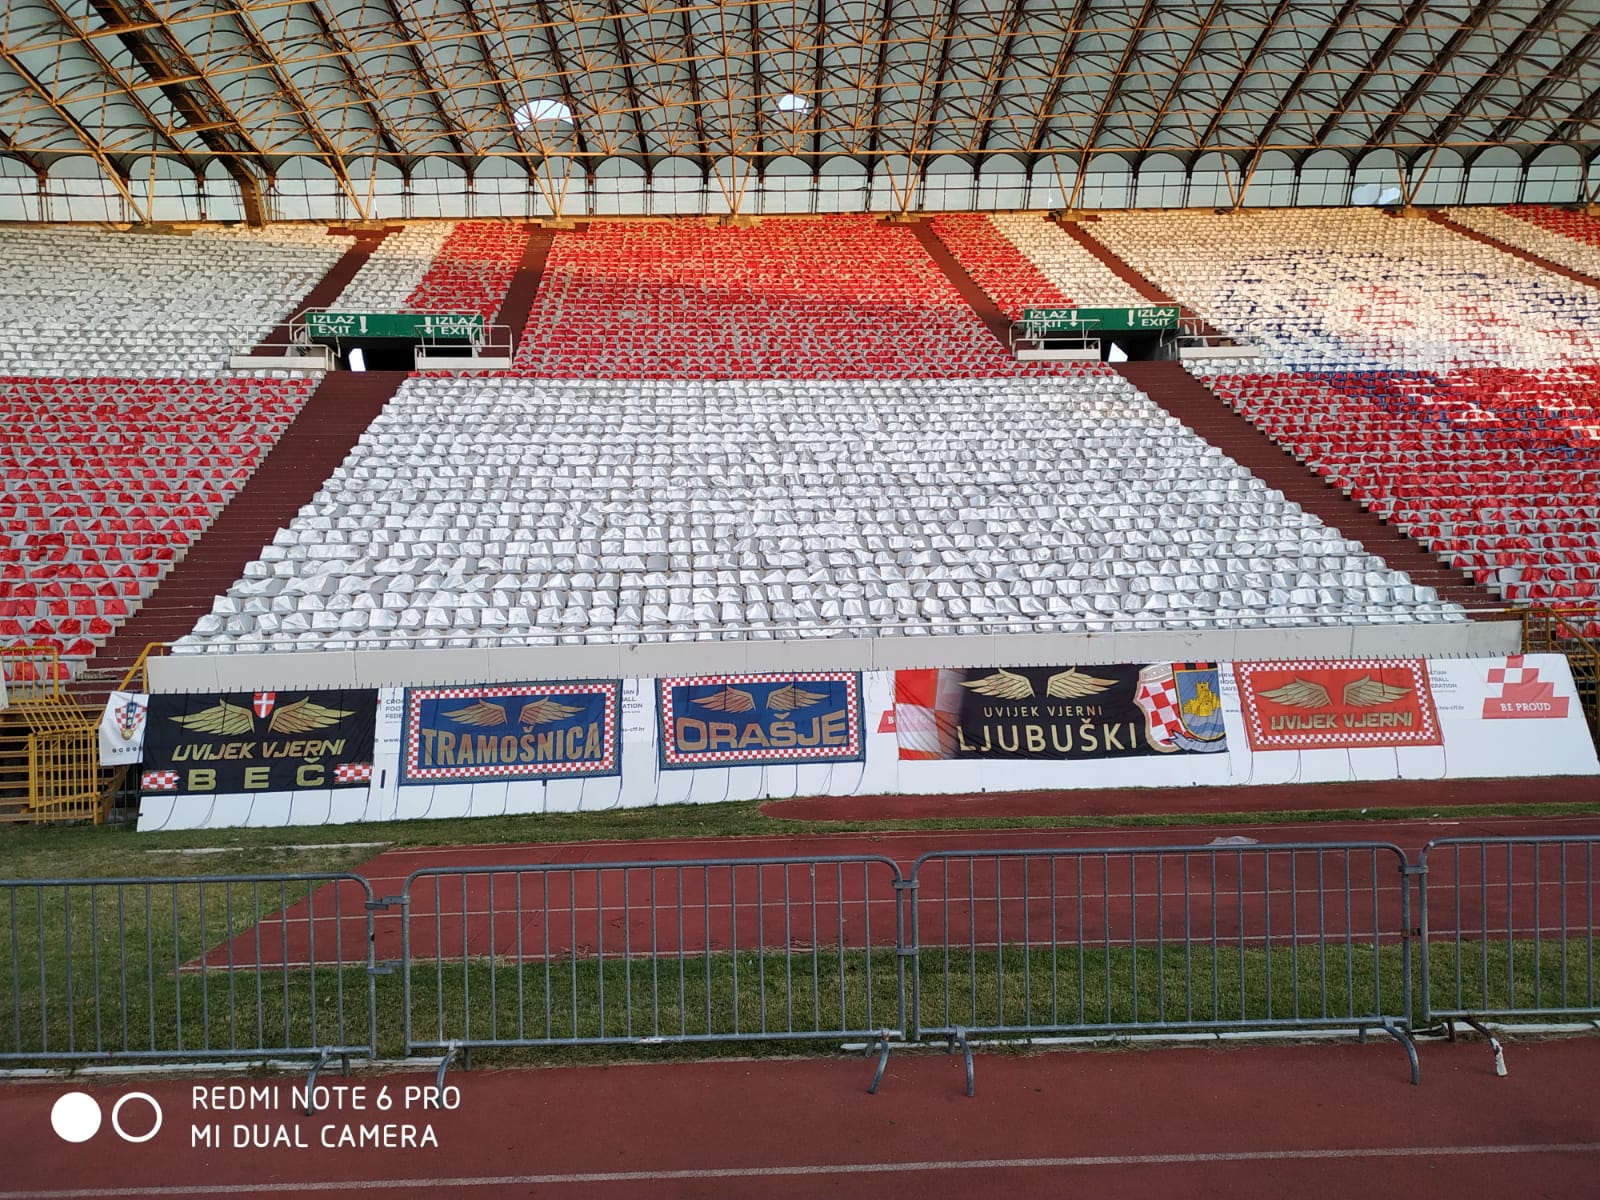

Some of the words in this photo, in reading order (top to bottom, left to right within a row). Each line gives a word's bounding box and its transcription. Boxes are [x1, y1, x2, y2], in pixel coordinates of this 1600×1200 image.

[1030, 310, 1067, 319] IZLAZ
[1137, 309, 1175, 317] IZLAZ
[312, 315, 355, 325] IZLAZ
[435, 316, 474, 325] IZLAZ
[1141, 318, 1170, 327] EXIT
[318, 325, 351, 334] EXIT
[441, 326, 472, 335] EXIT
[983, 706, 1039, 718] UVIJEK
[1046, 705, 1103, 717] VJERNI
[1500, 703, 1513, 712] BE
[1515, 702, 1551, 712] PROUD
[1271, 714, 1338, 730] UVIJEK
[1344, 712, 1413, 729] VJERNI
[676, 709, 848, 751] ORAŠJE
[958, 718, 1137, 752] LJUBUŠKI
[421, 722, 602, 766] TRAMOŠNICA
[171, 741, 256, 761] UVIJEK
[262, 739, 346, 759] VJERNI
